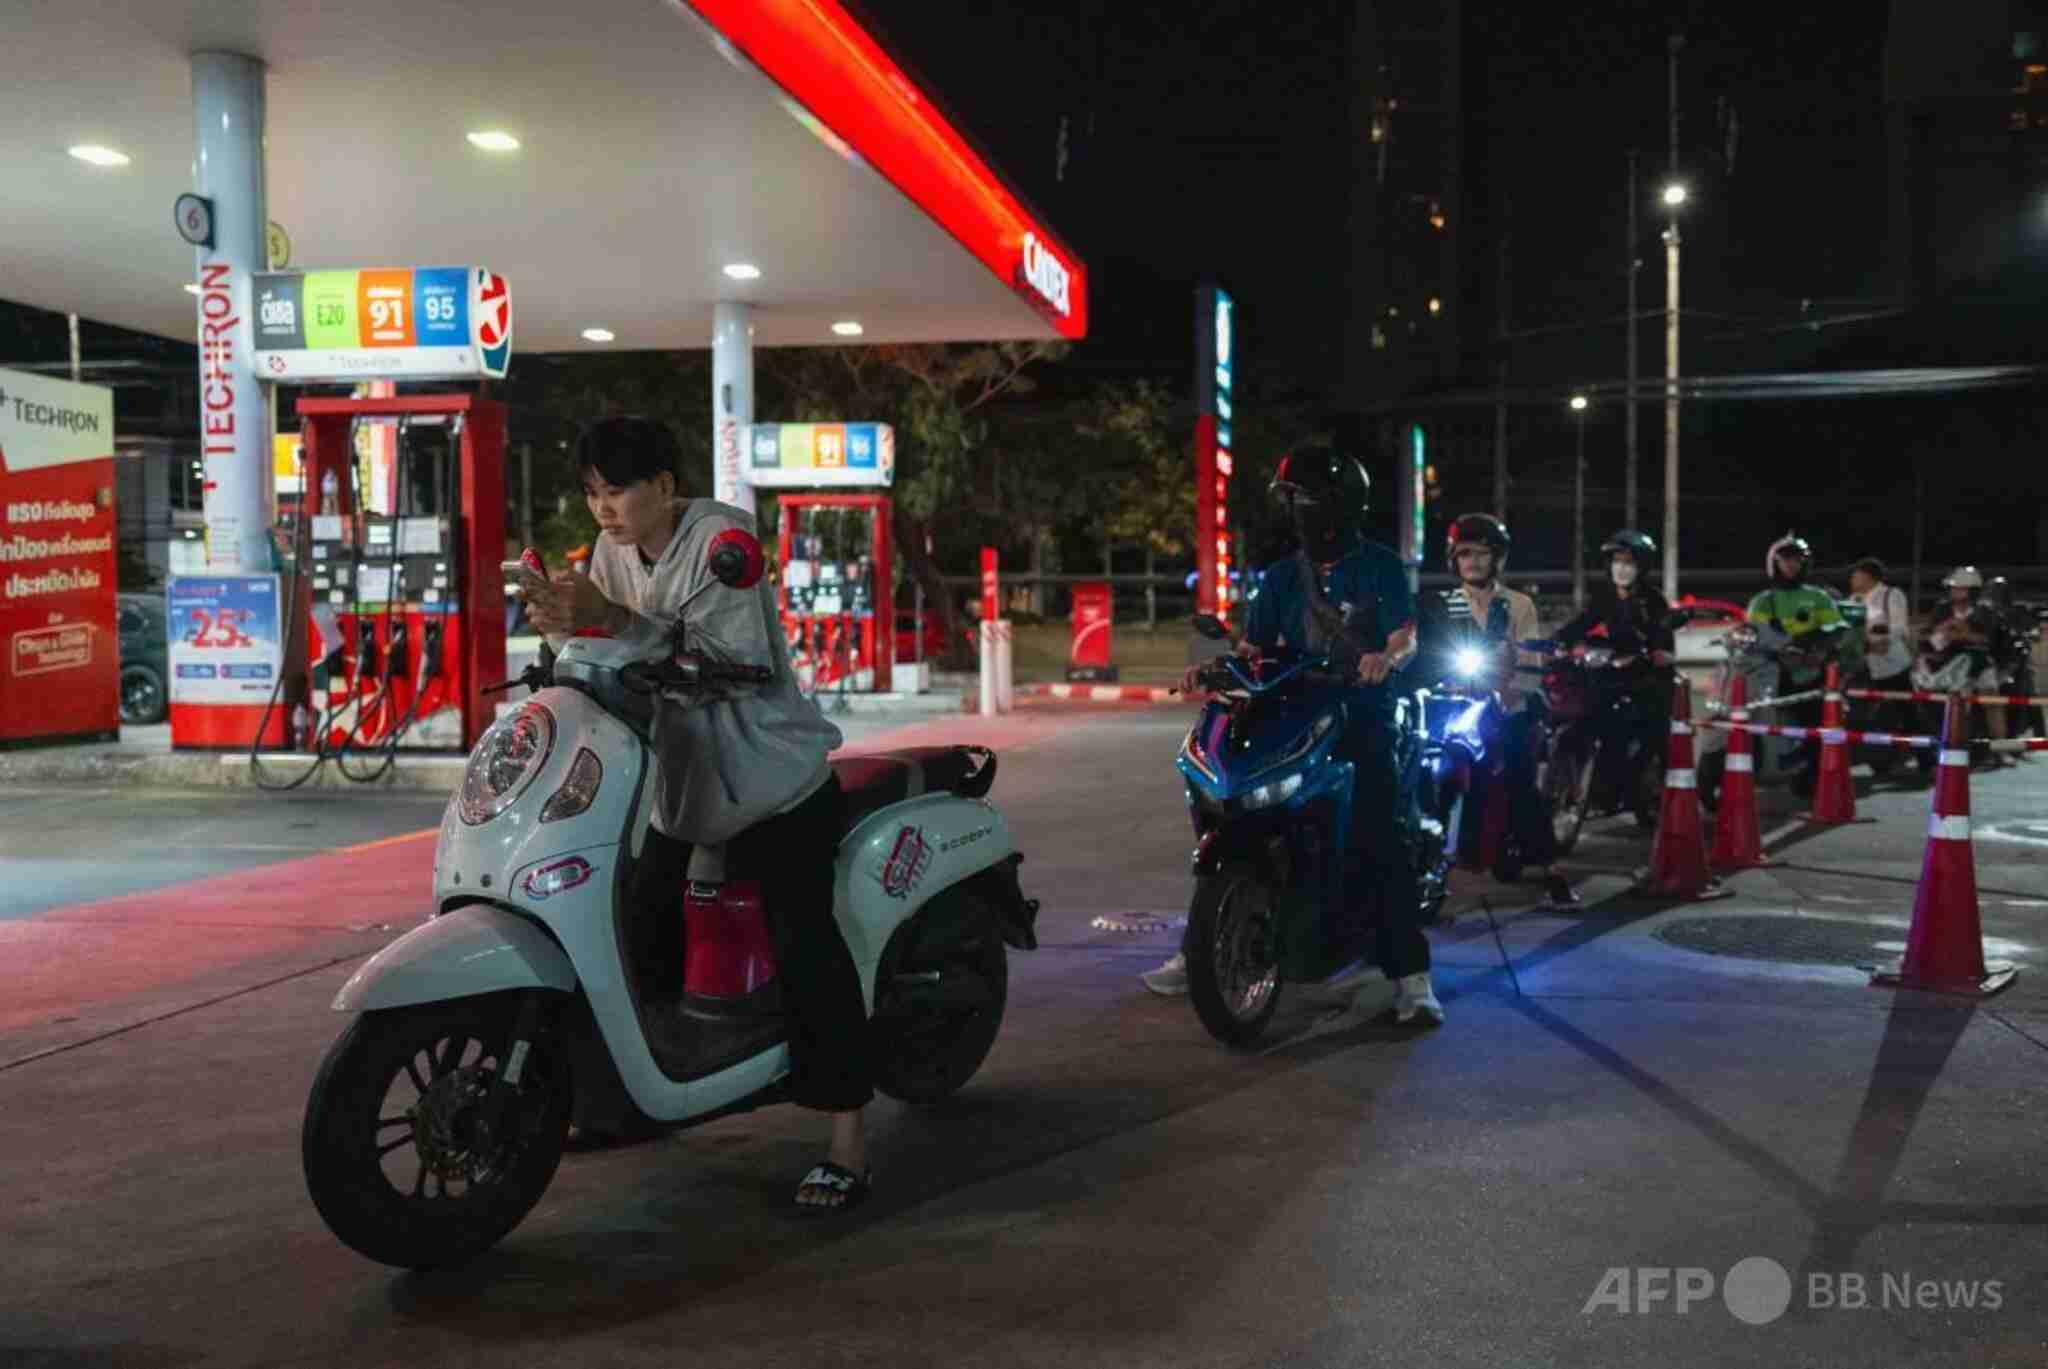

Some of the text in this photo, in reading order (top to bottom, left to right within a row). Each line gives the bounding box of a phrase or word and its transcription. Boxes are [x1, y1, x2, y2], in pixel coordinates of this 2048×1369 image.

[186, 208, 200, 230] 6
[317, 303, 344, 326] E20
[369, 300, 404, 328] 91
[425, 296, 455, 320] 95
[200, 264, 240, 454] TECHRON
[15, 397, 99, 435] TECHRON
